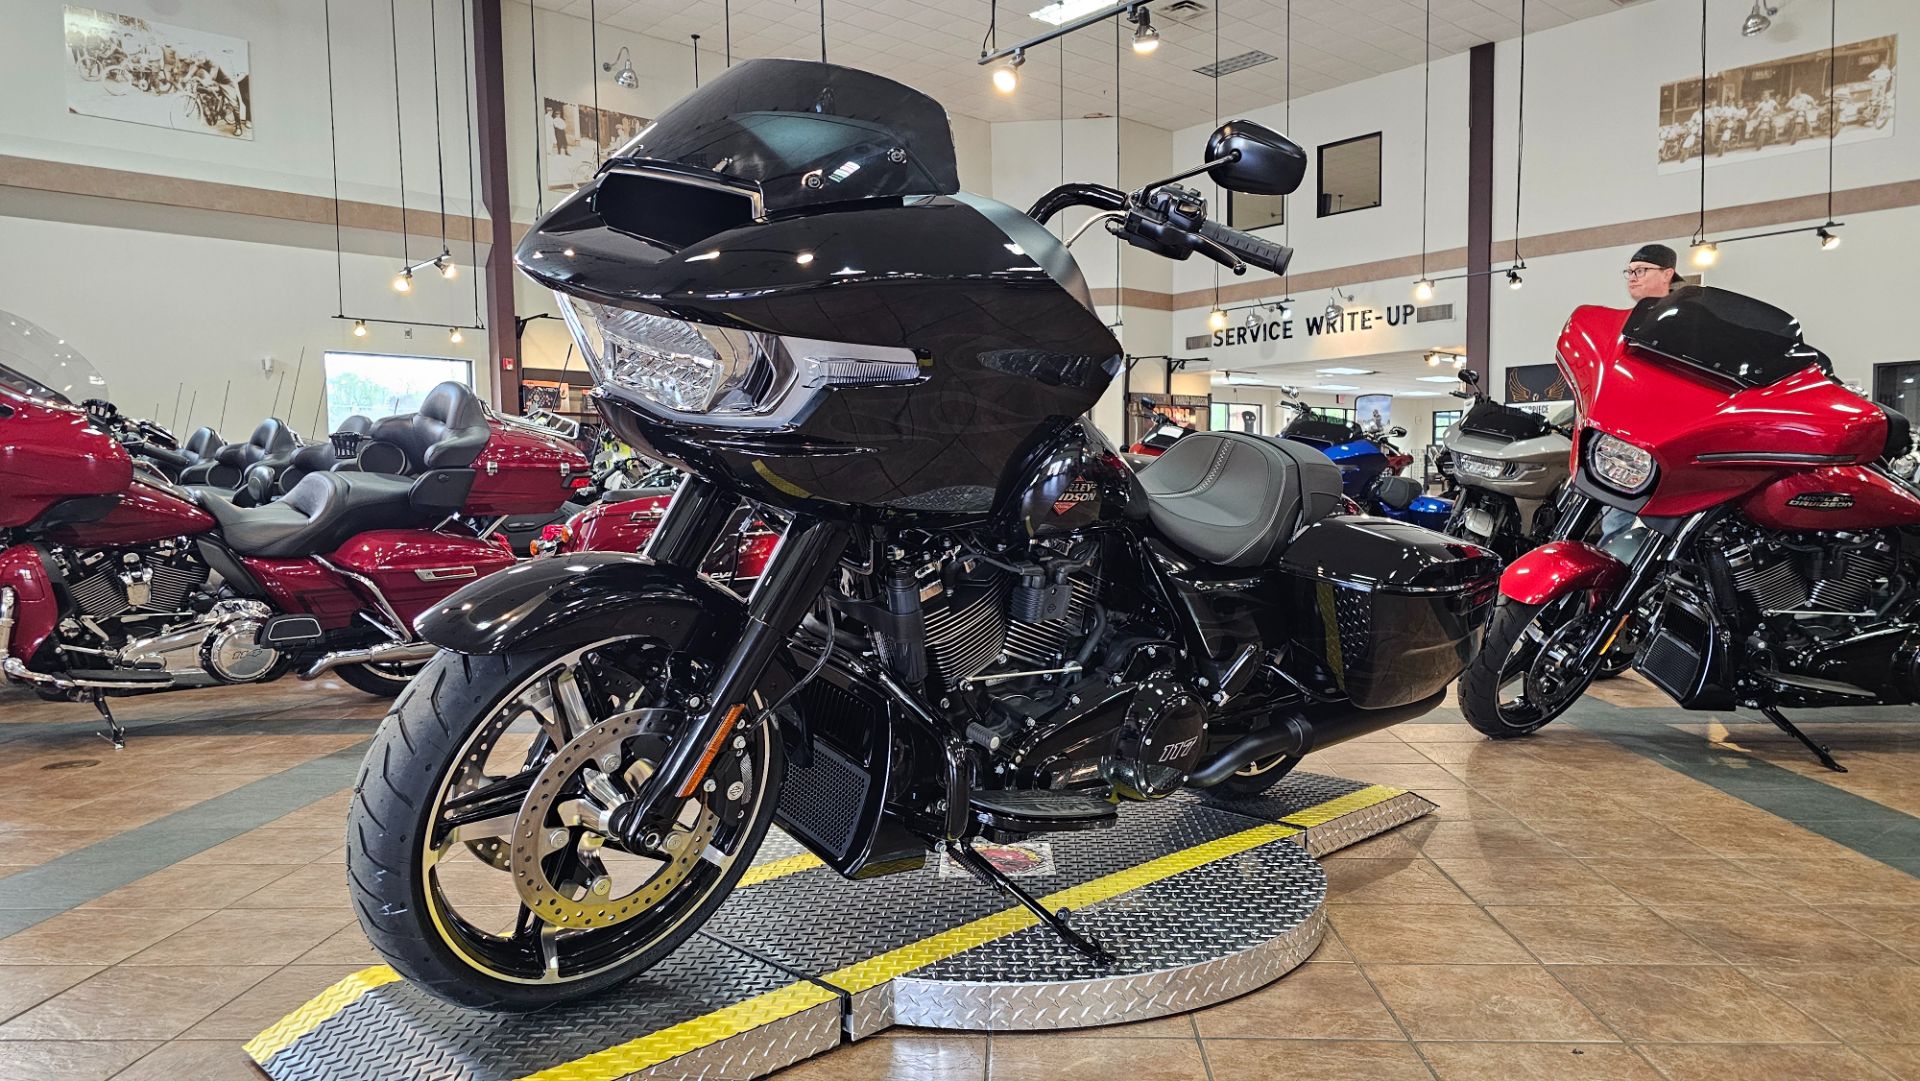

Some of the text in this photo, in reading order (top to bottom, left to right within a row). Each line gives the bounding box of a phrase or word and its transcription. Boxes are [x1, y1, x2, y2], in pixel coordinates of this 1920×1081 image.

[1213, 304, 1415, 348] SERVICE WRITE-UP
[1058, 492, 1097, 502] IDSON
[1158, 735, 1199, 763] 117
